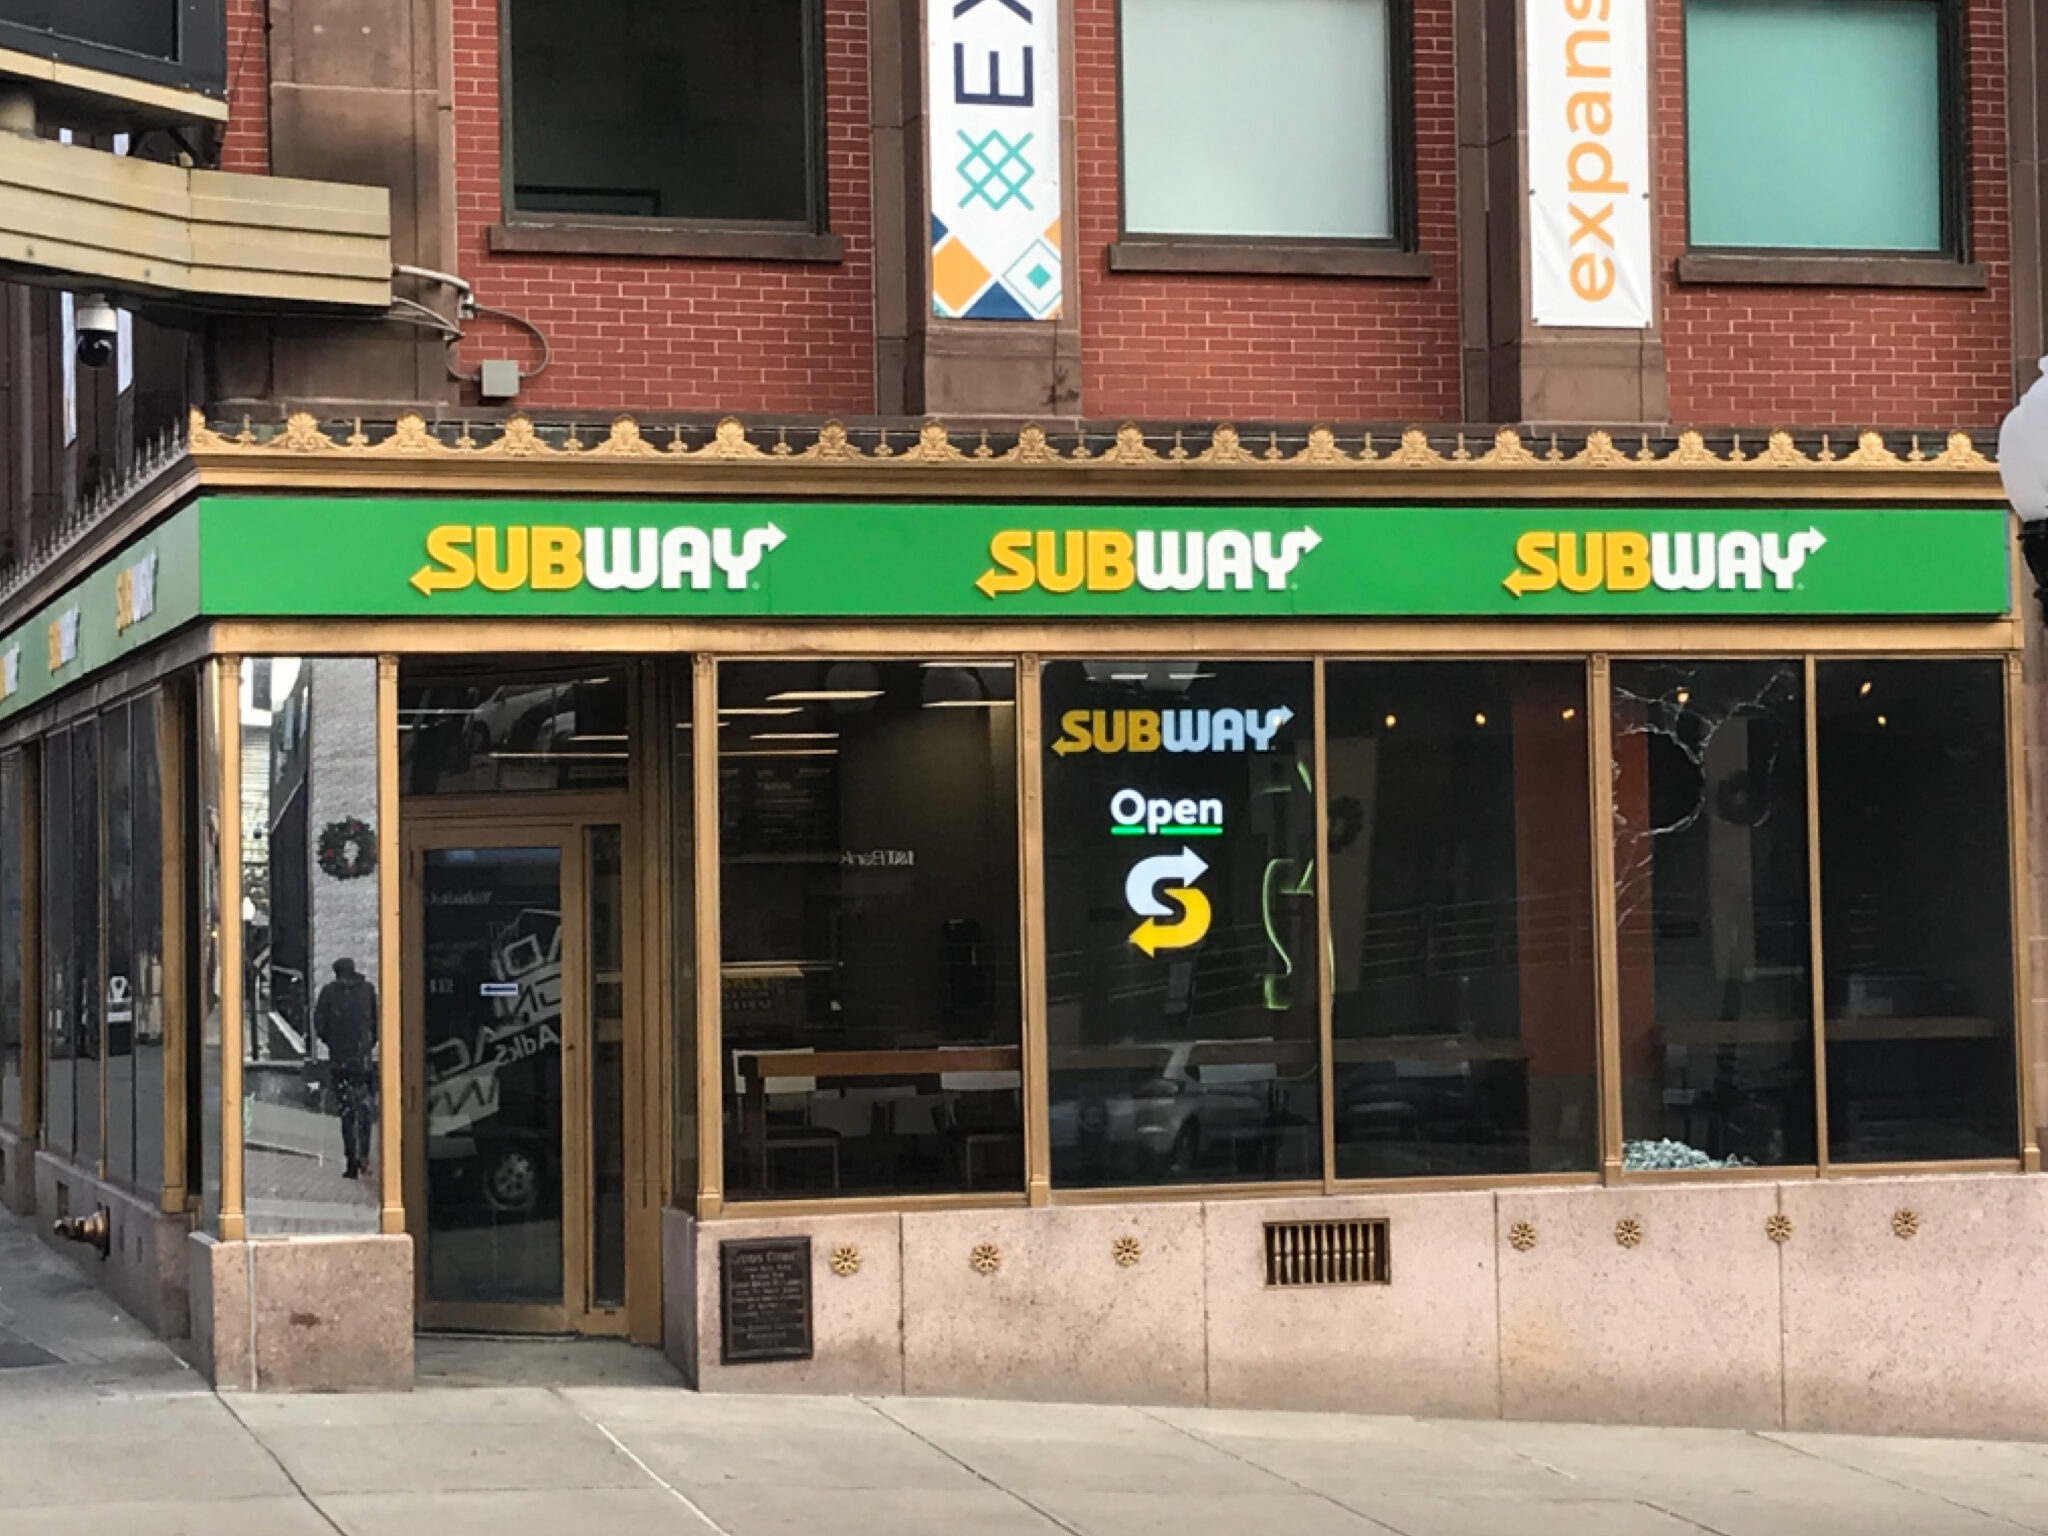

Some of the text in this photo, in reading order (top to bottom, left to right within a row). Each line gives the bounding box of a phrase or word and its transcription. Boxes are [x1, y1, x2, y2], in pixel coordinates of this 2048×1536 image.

[409, 521, 788, 597] SUBWAY
[975, 525, 1323, 599] SUBWAY
[1502, 525, 1828, 598] SUBWAY
[1051, 705, 1294, 757] SUBWAY
[1110, 787, 1224, 836] Open
